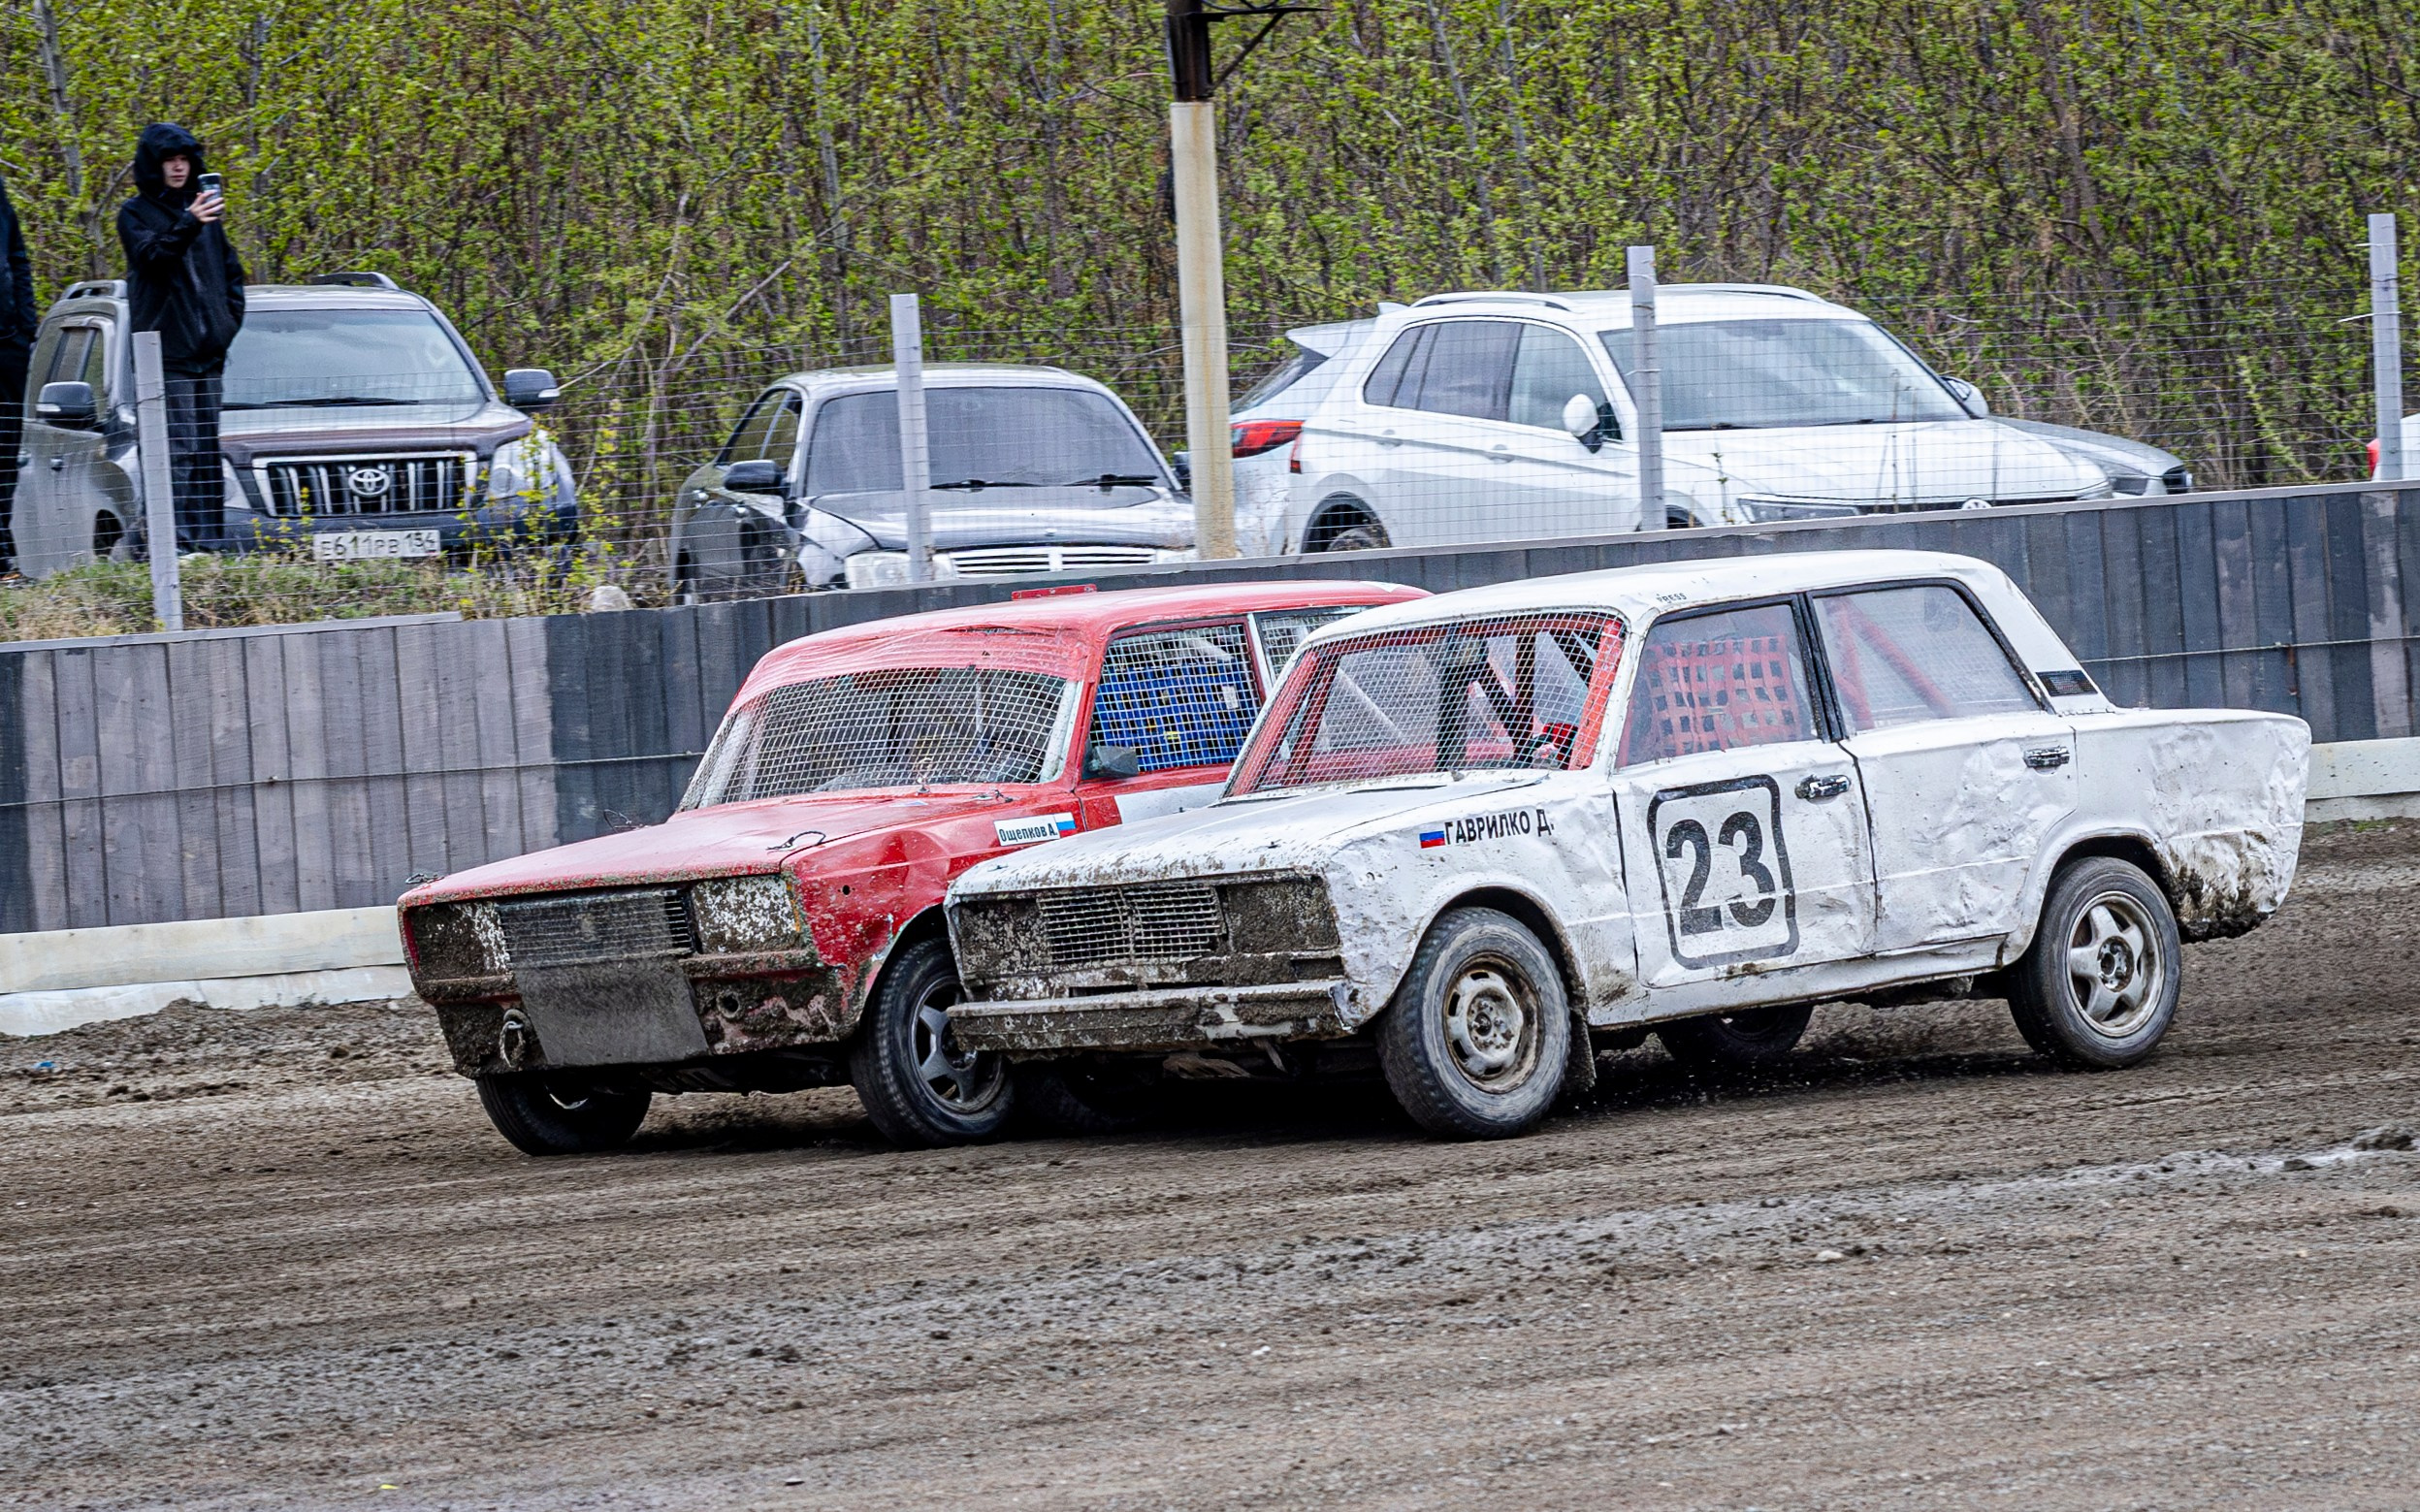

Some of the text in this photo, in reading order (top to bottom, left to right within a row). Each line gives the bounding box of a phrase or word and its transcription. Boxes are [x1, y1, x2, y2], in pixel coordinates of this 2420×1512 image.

[998, 822, 1058, 842] Ощепков А.
[1444, 808, 1555, 845] ГАВРИЛКО Д.
[1666, 811, 1776, 937] 23
